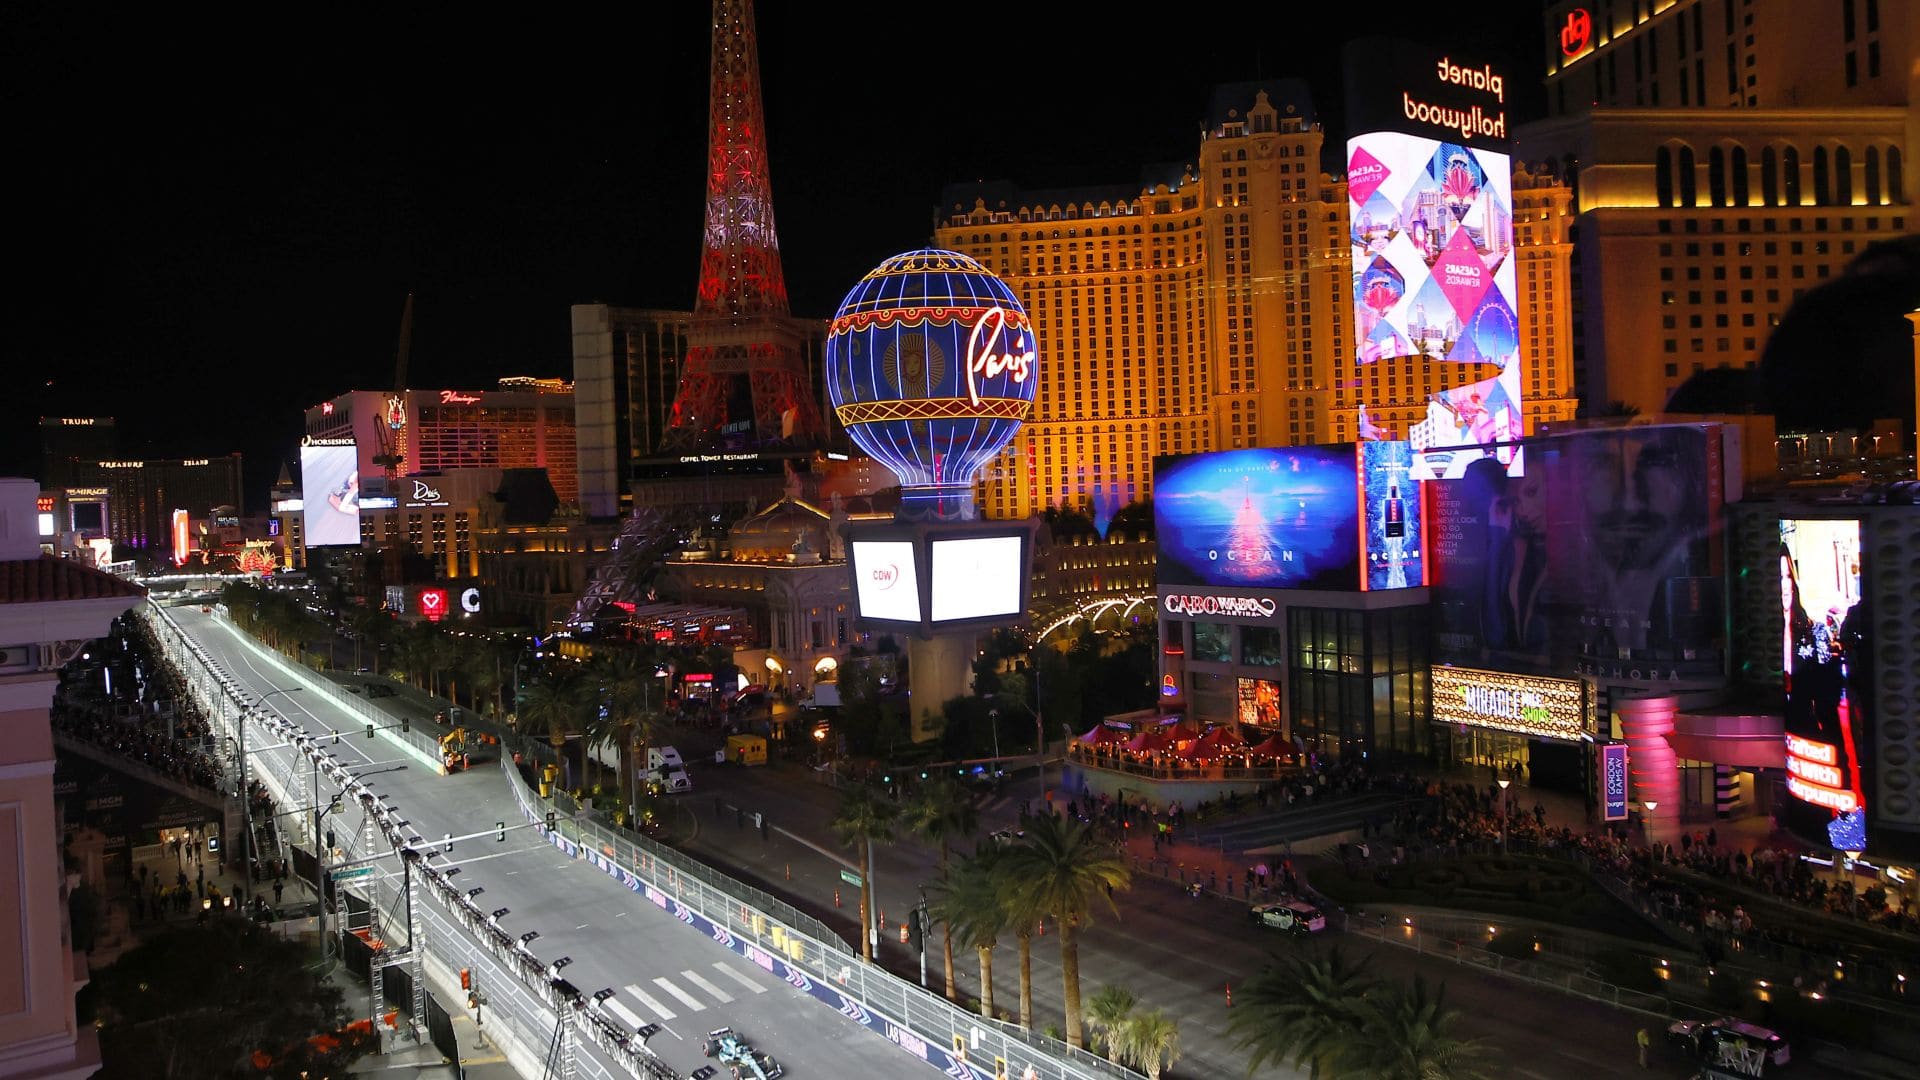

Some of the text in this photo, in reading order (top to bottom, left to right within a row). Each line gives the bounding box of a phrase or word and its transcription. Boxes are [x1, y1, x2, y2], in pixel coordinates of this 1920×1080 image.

[967, 306, 1035, 407] Paris
[311, 438, 355, 446] HORSESHOE
[723, 453, 758, 461] RESTAURANT
[1208, 550, 1293, 562] OCEAN
[1371, 550, 1419, 562] OCEAN
[873, 569, 892, 581] CDW
[1164, 594, 1218, 616] CABO
[1575, 662, 1679, 681] SEPHORA
[1465, 686, 1520, 719] MIRACLE
[1522, 706, 1550, 723] SHOPS
[1608, 757, 1616, 795] GORDON
[1615, 757, 1623, 795] RAMSAY
